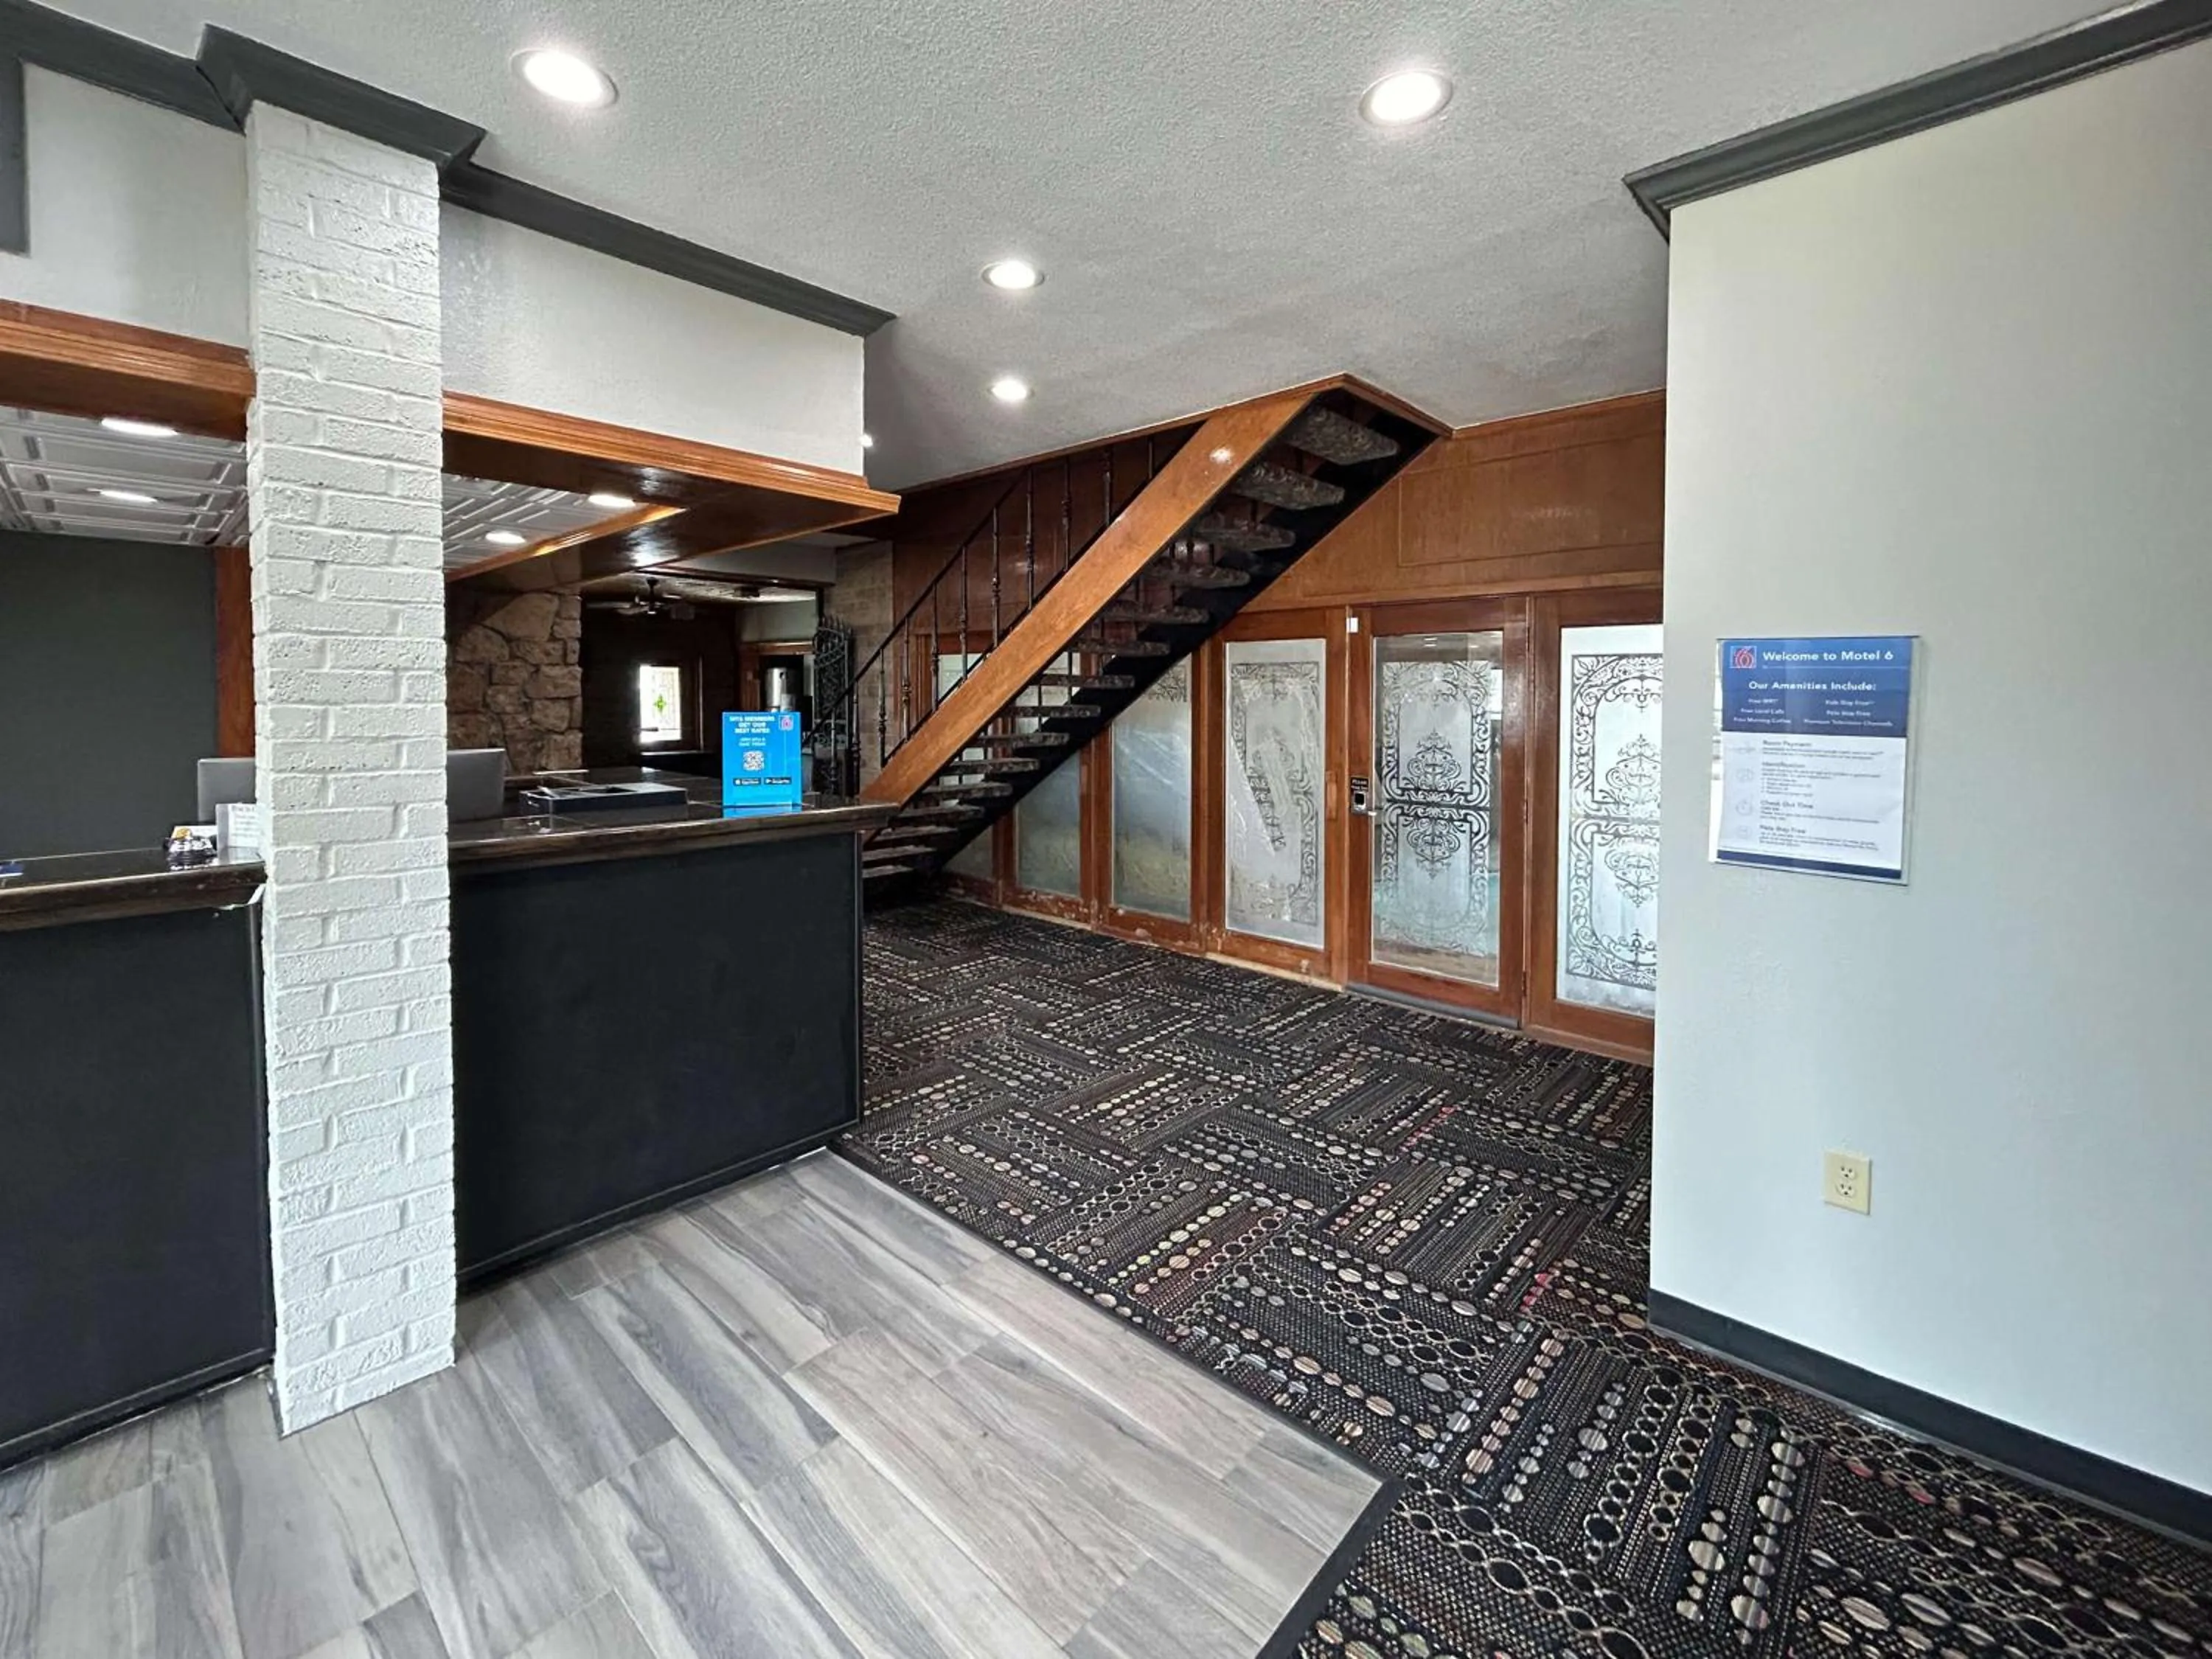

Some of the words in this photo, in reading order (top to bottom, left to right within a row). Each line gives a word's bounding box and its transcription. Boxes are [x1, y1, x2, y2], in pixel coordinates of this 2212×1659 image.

[1763, 651, 1819, 661] Welcome
[1823, 652, 1837, 661] to
[1841, 650, 1880, 661] Motel
[1884, 650, 1894, 661] 6
[1748, 681, 1768, 689] Our
[1772, 681, 1827, 690] Amenities
[1831, 681, 1877, 691] Include:
